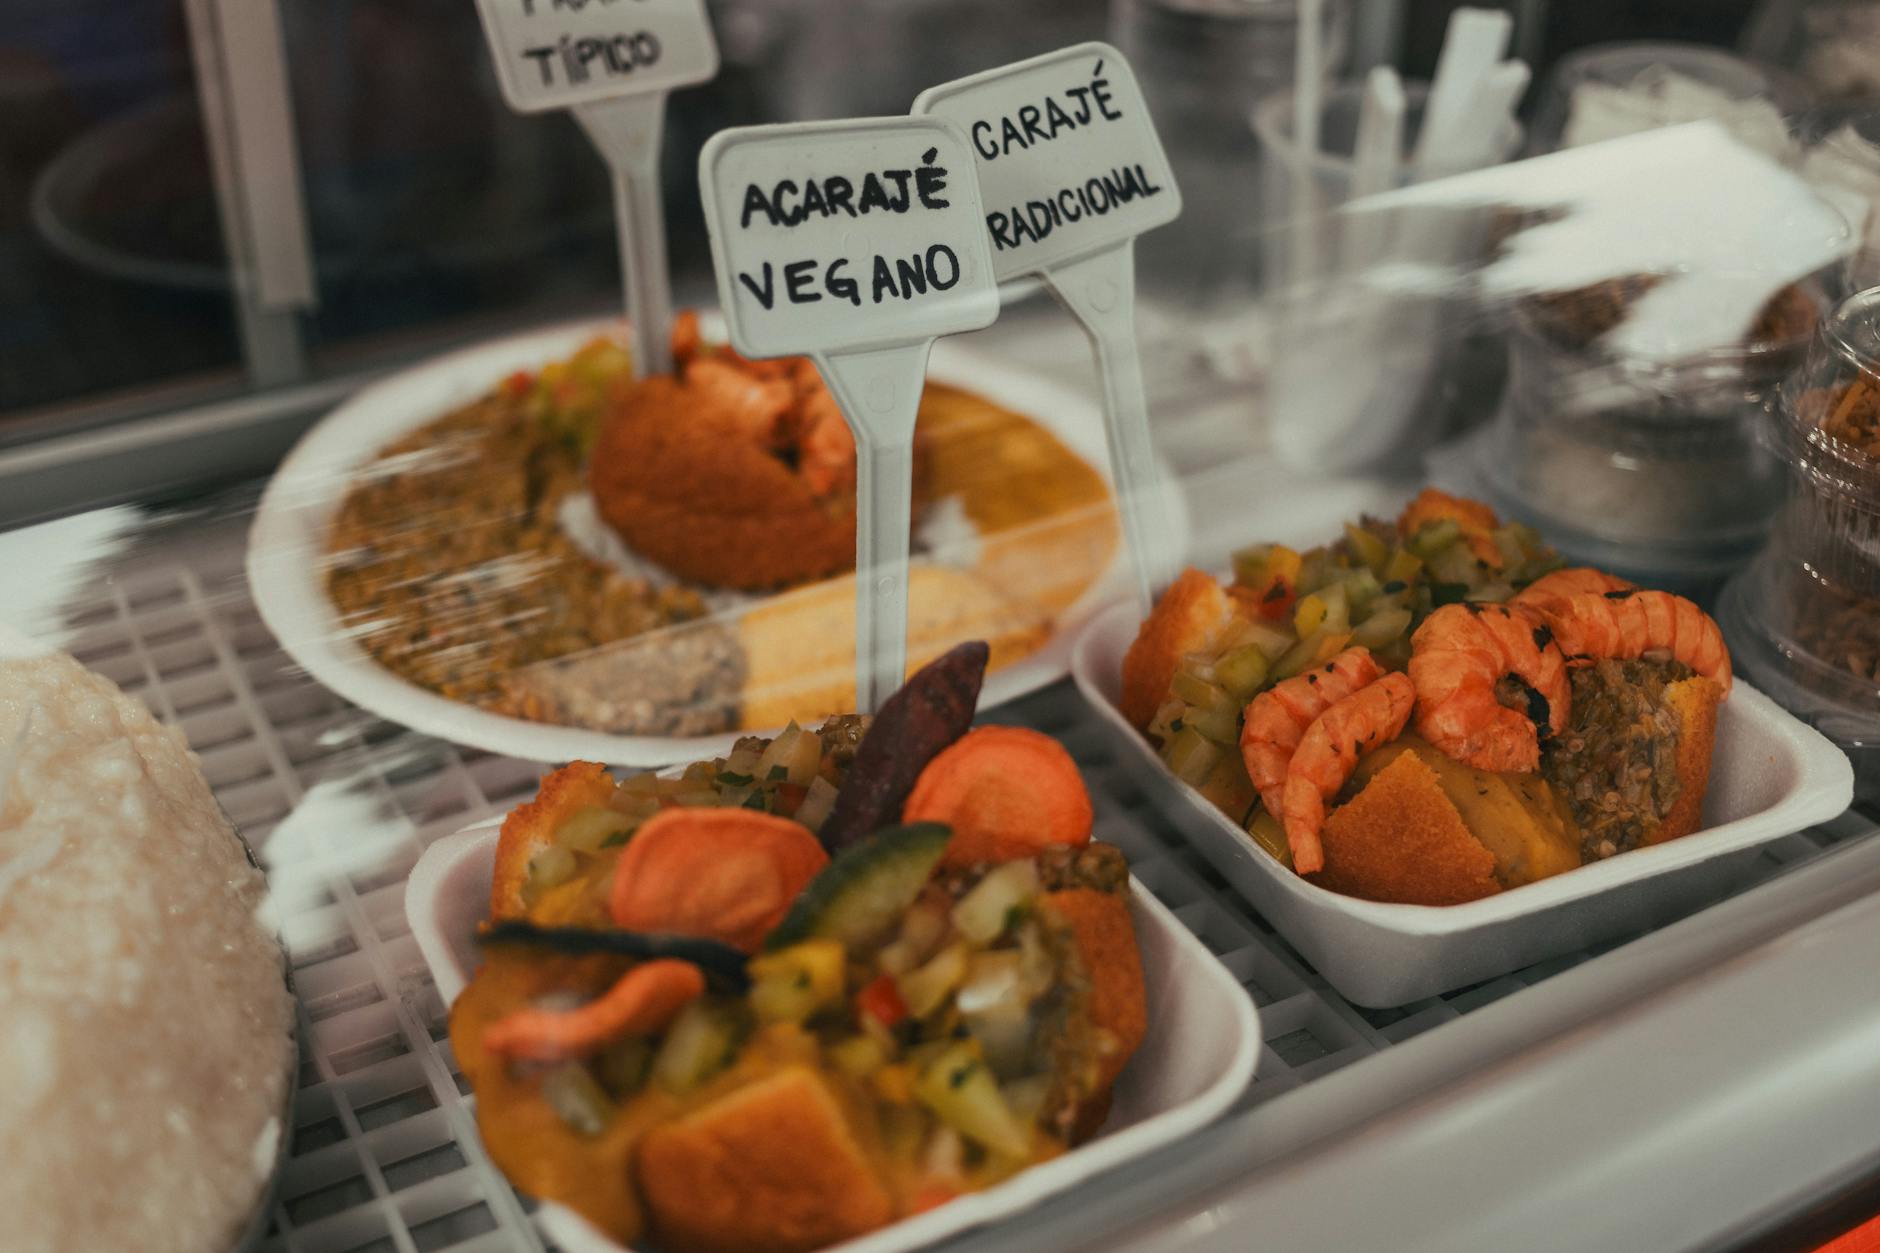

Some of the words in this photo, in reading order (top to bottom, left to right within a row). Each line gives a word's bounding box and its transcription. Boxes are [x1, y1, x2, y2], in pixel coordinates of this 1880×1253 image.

[521, 33, 662, 87] TÍPICO
[971, 60, 1122, 160] CARAJÉ
[741, 147, 950, 229] ACARAJÉ
[986, 164, 1161, 251] RADICIONAL
[739, 244, 960, 310] VEGANO
